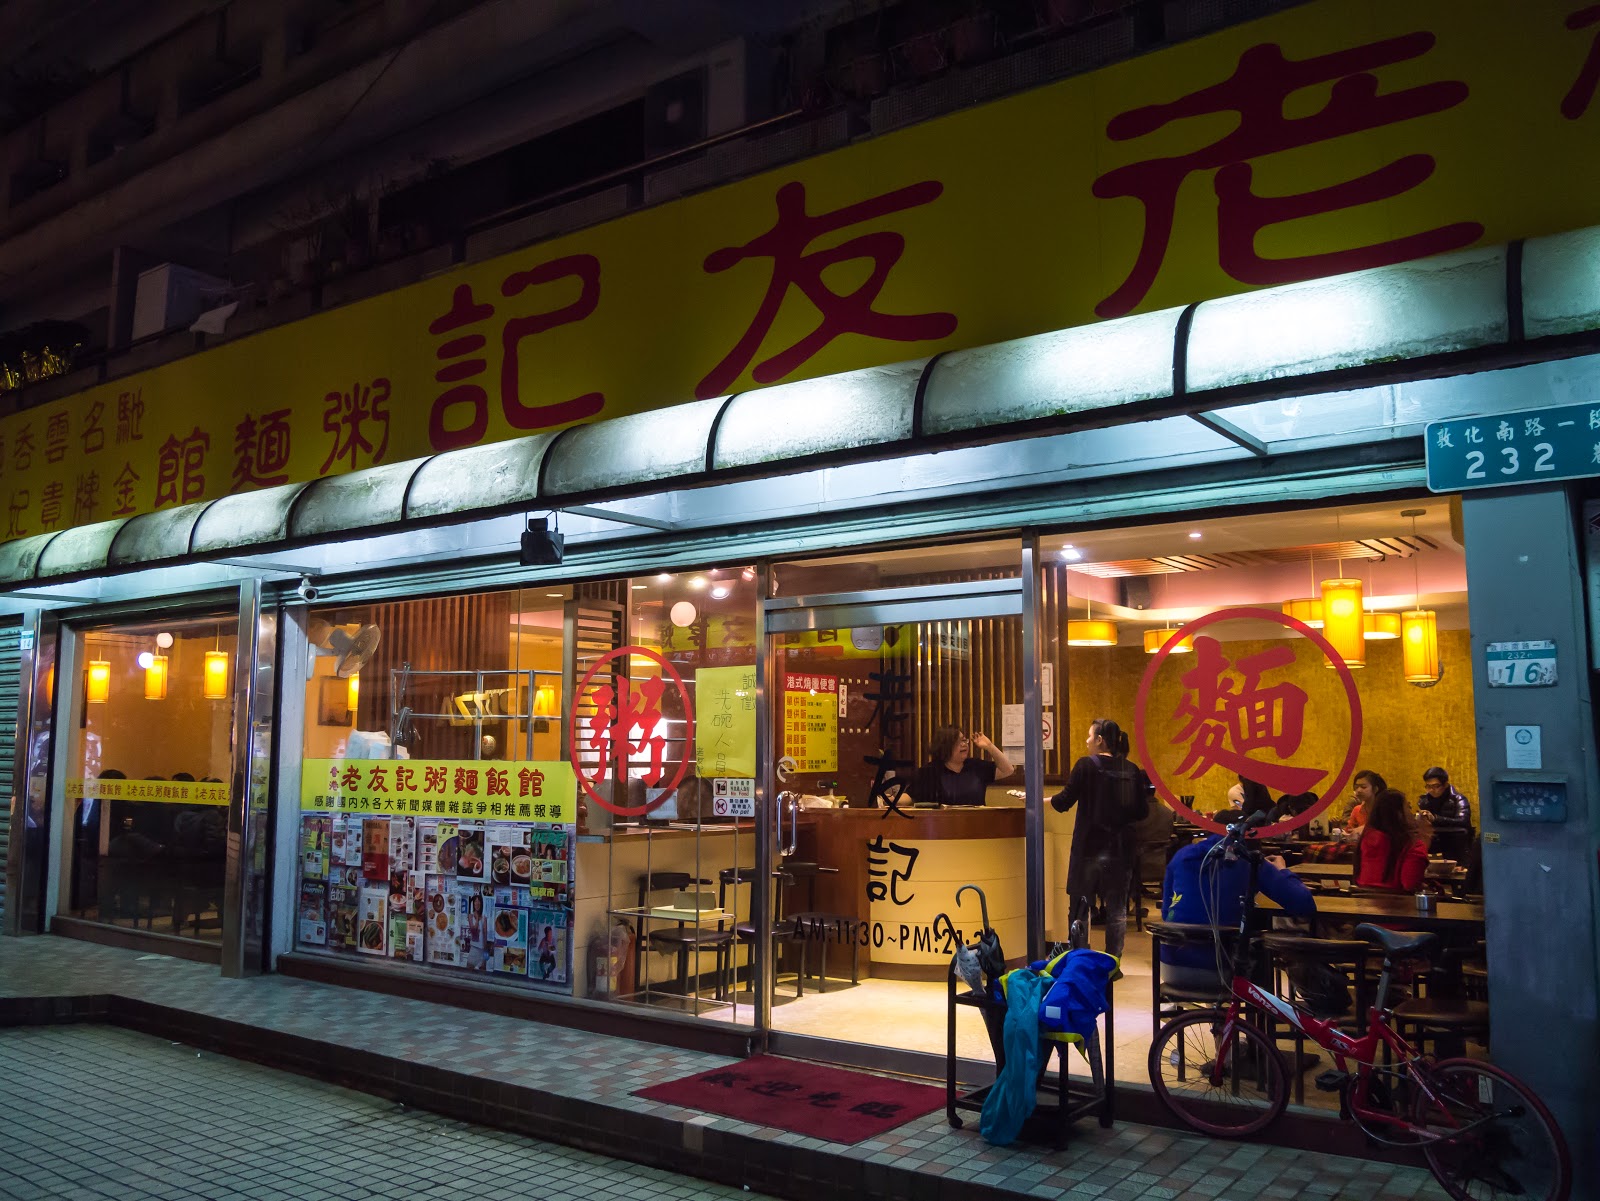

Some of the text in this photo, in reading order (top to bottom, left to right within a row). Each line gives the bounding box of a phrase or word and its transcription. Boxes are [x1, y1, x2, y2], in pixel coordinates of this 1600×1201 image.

[0, 385, 144, 480] 馳名雲吞
[588, 675, 667, 788] 粥
[1170, 638, 1329, 796] 麵
[199, 787, 231, 801] 老友記
[340, 765, 545, 798] 老友記粥麵飯館
[863, 668, 919, 906] 老友記
